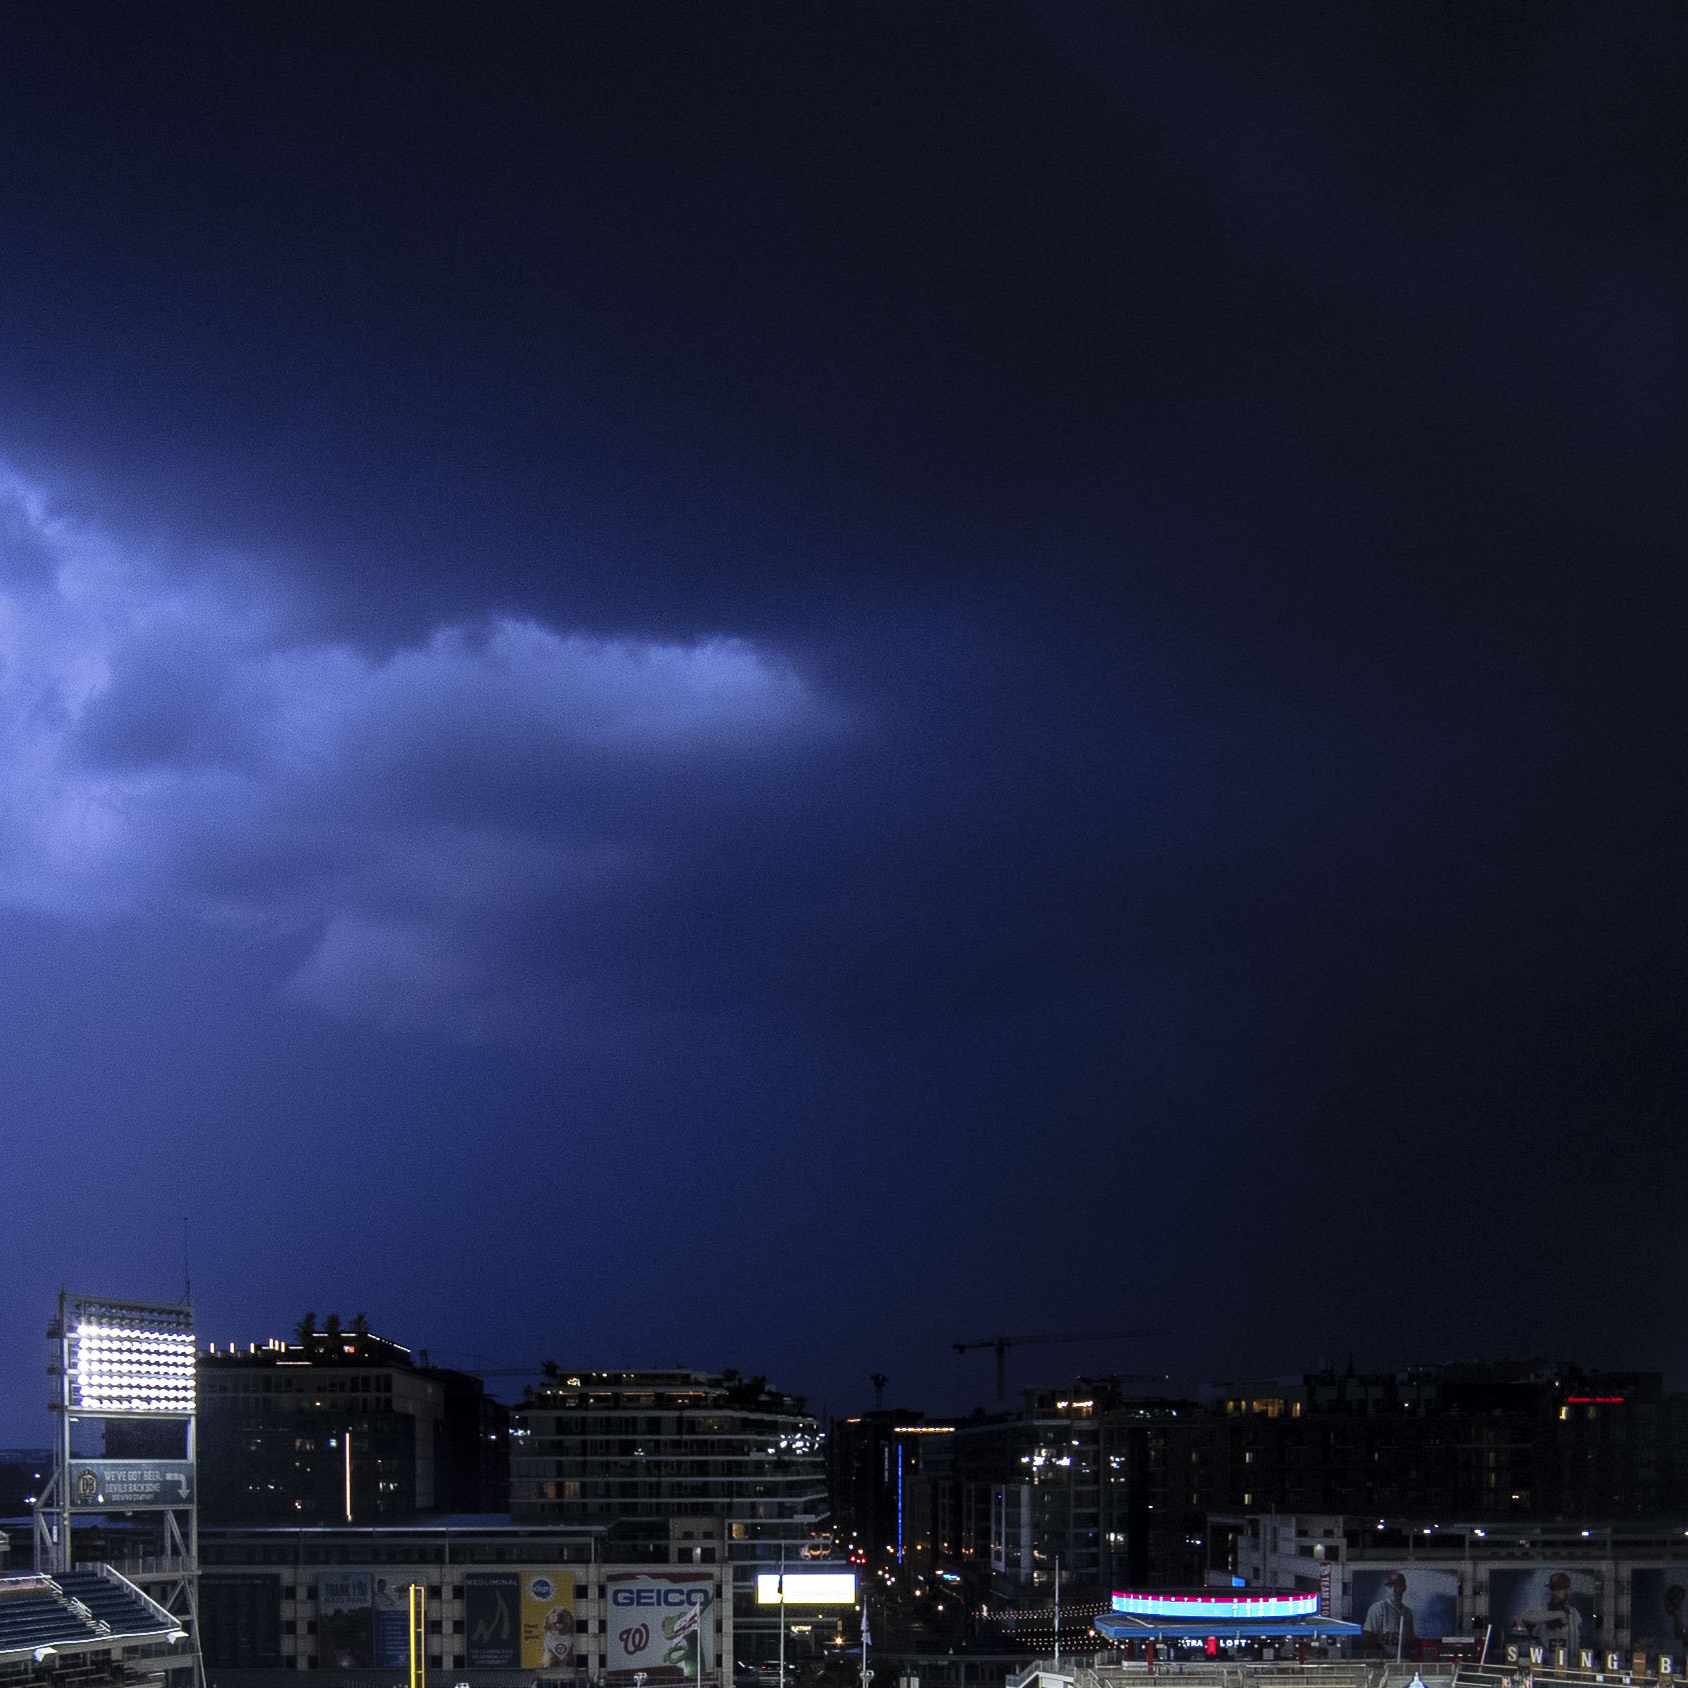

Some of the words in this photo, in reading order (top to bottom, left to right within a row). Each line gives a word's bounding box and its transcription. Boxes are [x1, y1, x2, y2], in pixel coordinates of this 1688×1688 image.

[613, 1589, 709, 1606] GEICO
[1220, 1639, 1246, 1647] LOFT
[1507, 1647, 1618, 1670] SWING
